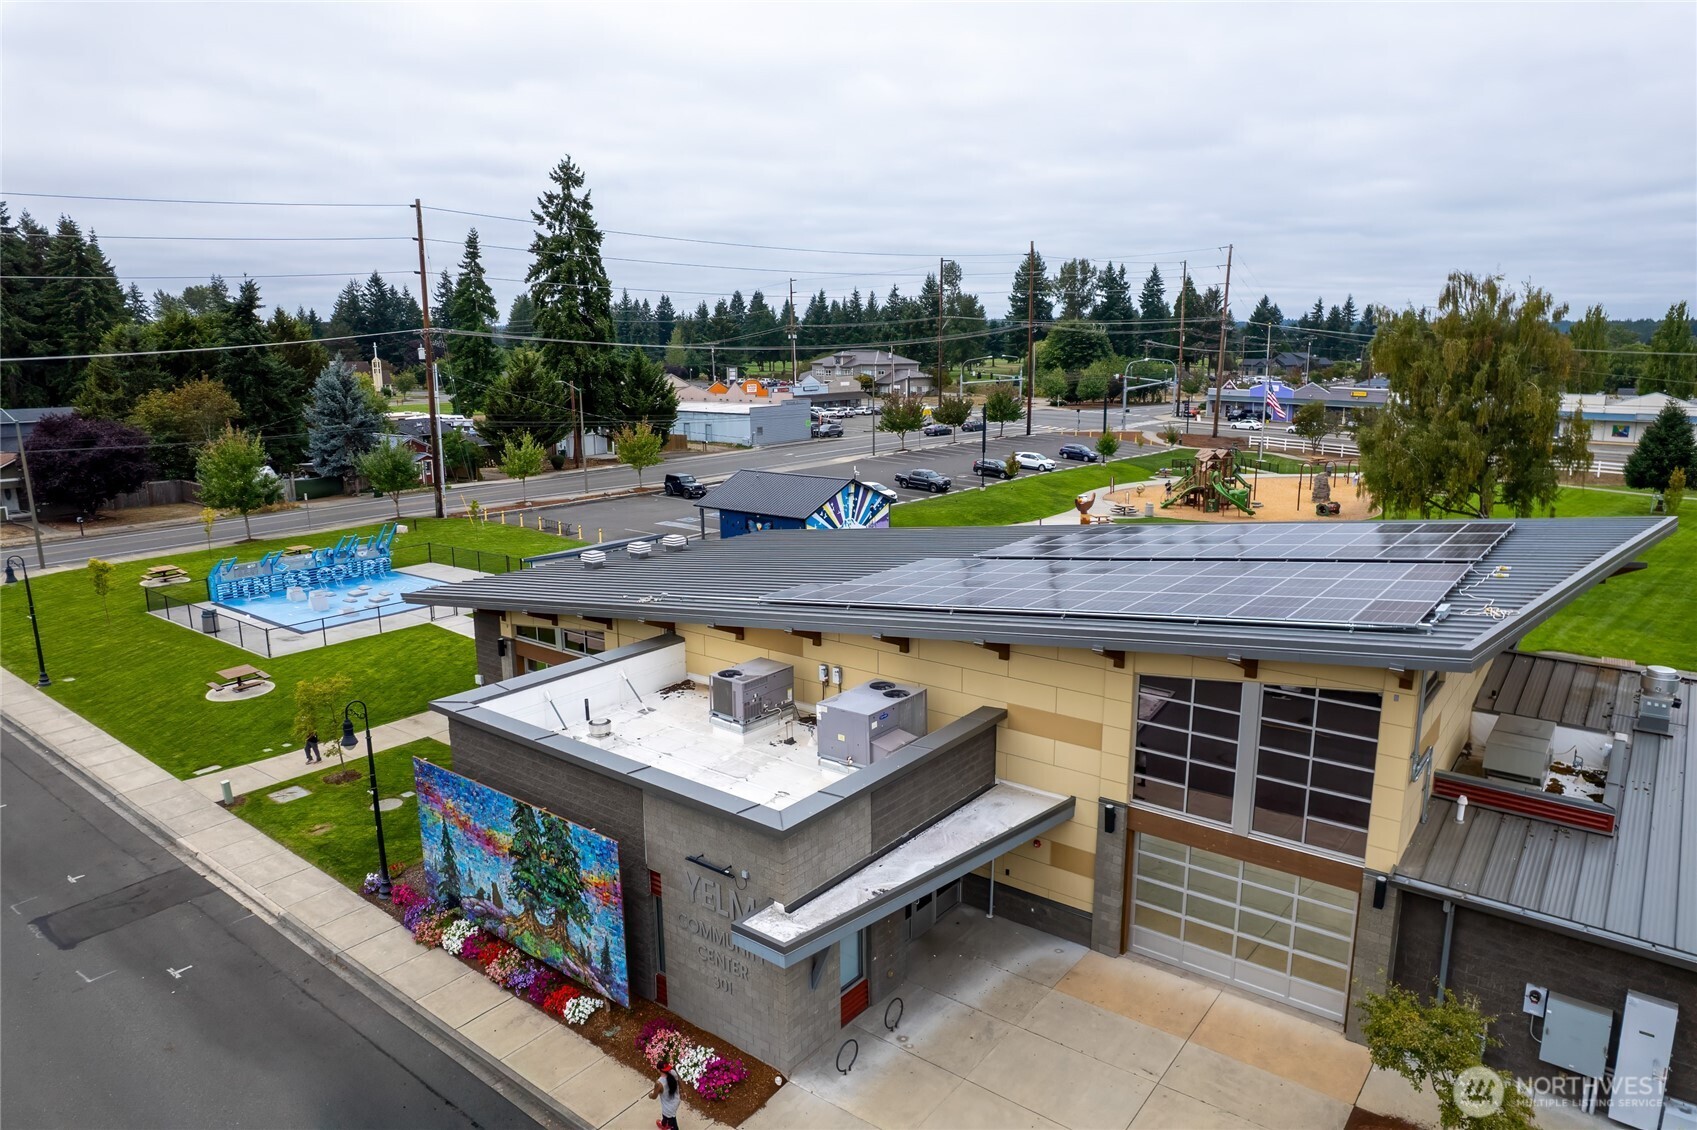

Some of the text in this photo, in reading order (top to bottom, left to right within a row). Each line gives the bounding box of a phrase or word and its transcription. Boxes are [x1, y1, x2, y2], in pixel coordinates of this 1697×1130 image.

[678, 912, 765, 966] COMMU
[698, 945, 749, 981] CENTER
[713, 975, 734, 996] 301
